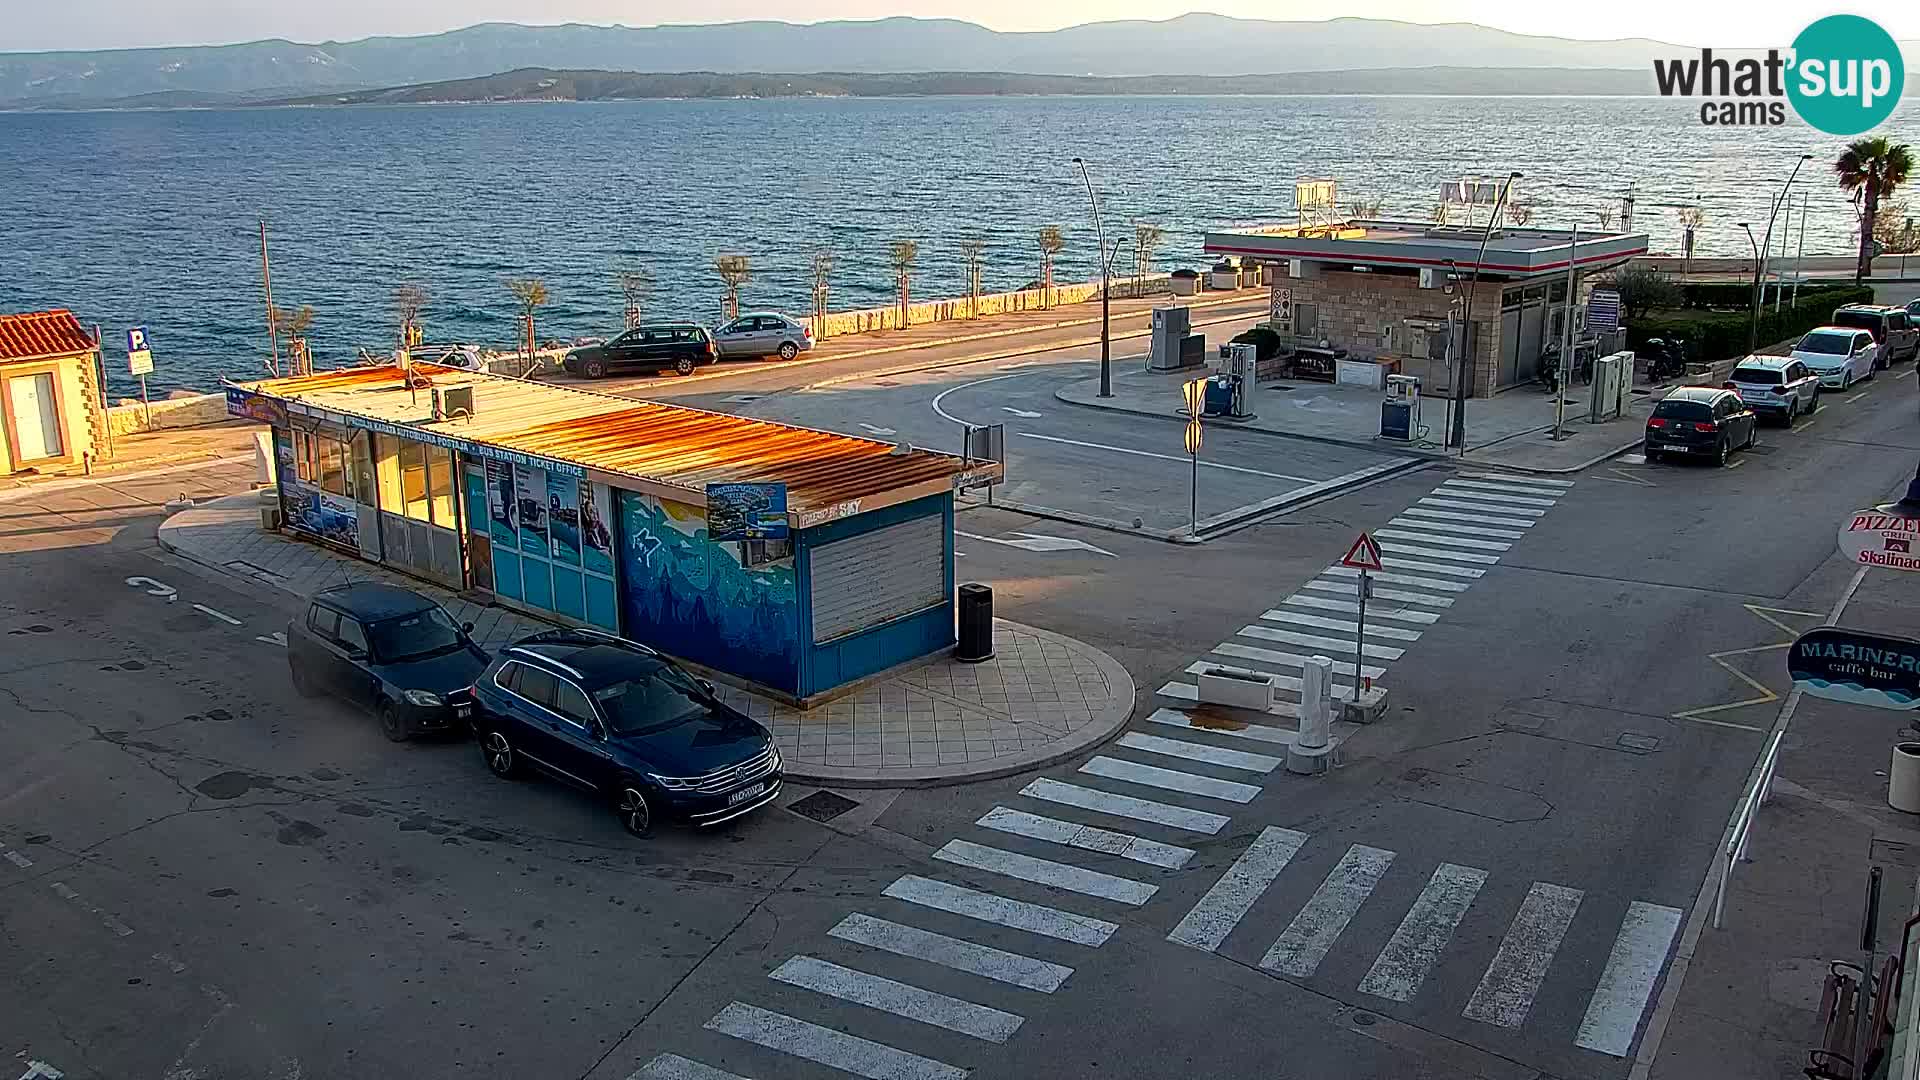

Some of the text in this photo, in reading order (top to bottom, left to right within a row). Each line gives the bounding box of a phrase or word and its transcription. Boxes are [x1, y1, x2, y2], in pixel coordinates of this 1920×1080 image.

[131, 330, 144, 350] P
[437, 437, 468, 452] POSTAJA
[479, 446, 494, 457] BUS
[495, 450, 527, 464] STATION
[529, 457, 554, 470] TICKET
[556, 464, 582, 477] OFFICE
[1847, 515, 1920, 534] PIZZE
[1881, 531, 1917, 540] GRILL
[1828, 663, 1896, 680] caffe bar
